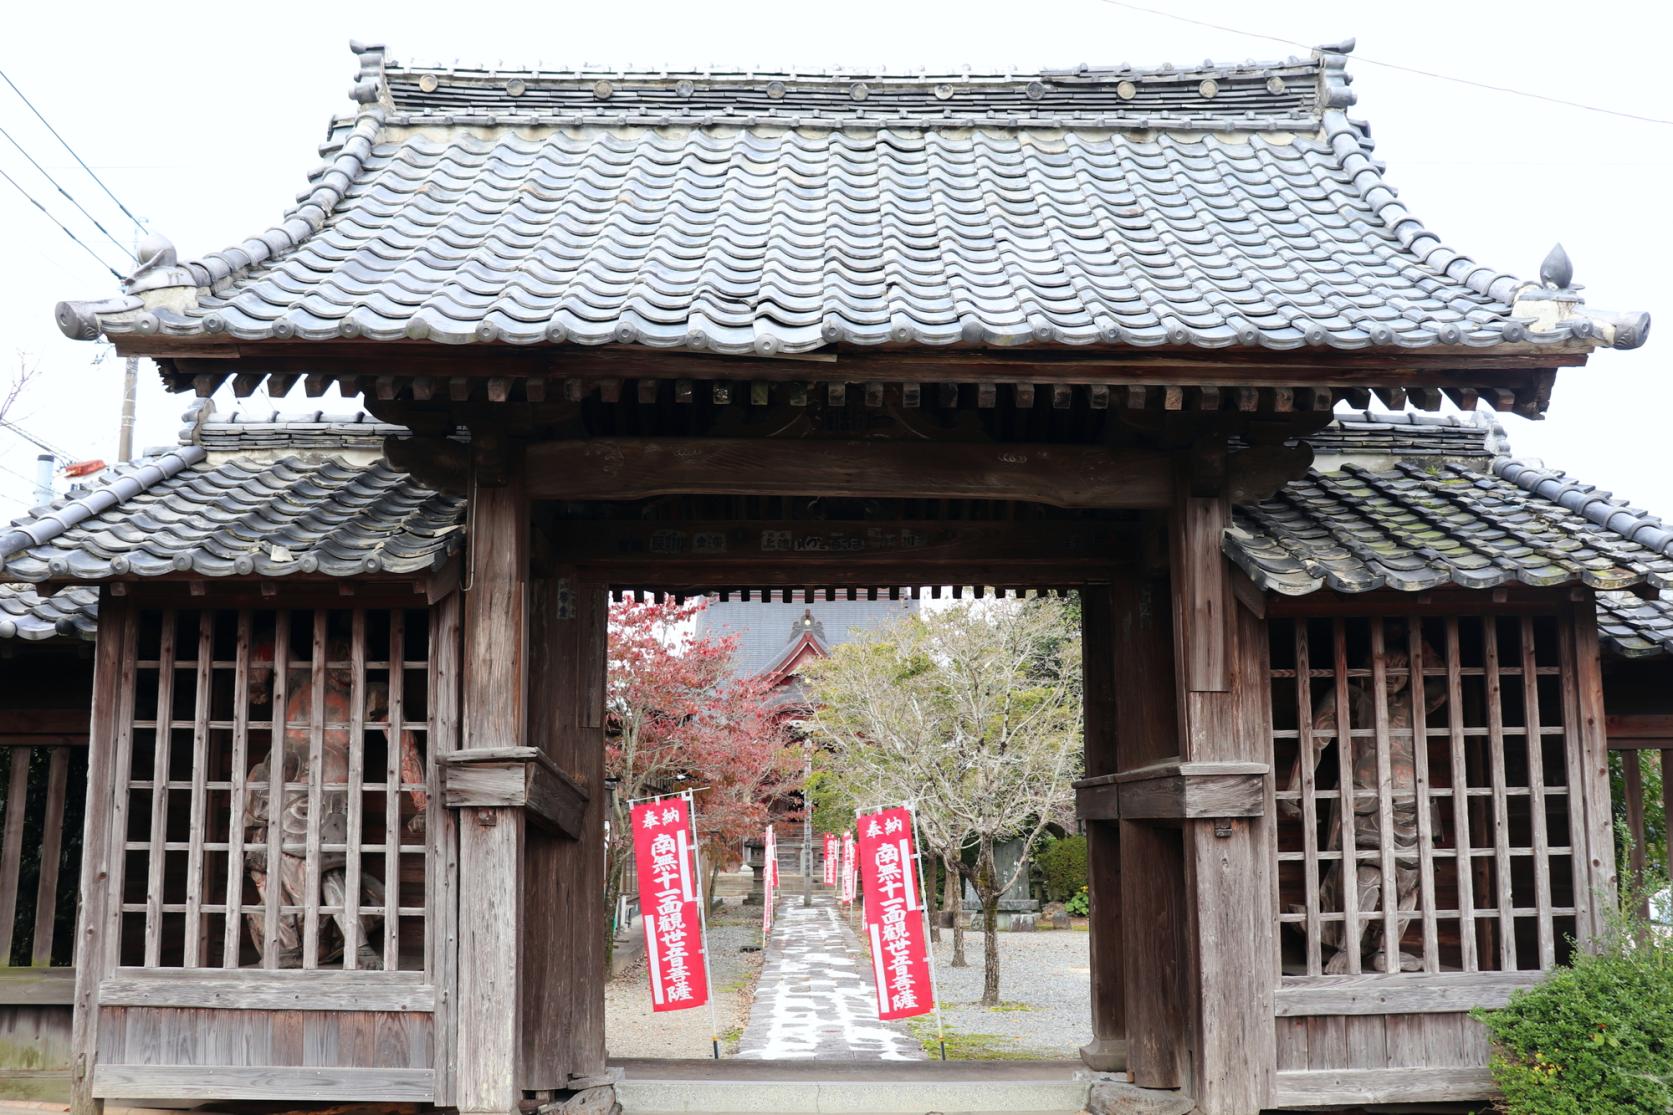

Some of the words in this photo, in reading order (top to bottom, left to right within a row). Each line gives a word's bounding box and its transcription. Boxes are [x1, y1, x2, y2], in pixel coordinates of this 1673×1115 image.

[642, 807, 680, 829] 奉納
[866, 816, 903, 838] 奉納
[651, 833, 693, 1003] 南無十一面観世音菩薩
[875, 842, 918, 1011] 南無十一面観世音菩薩
